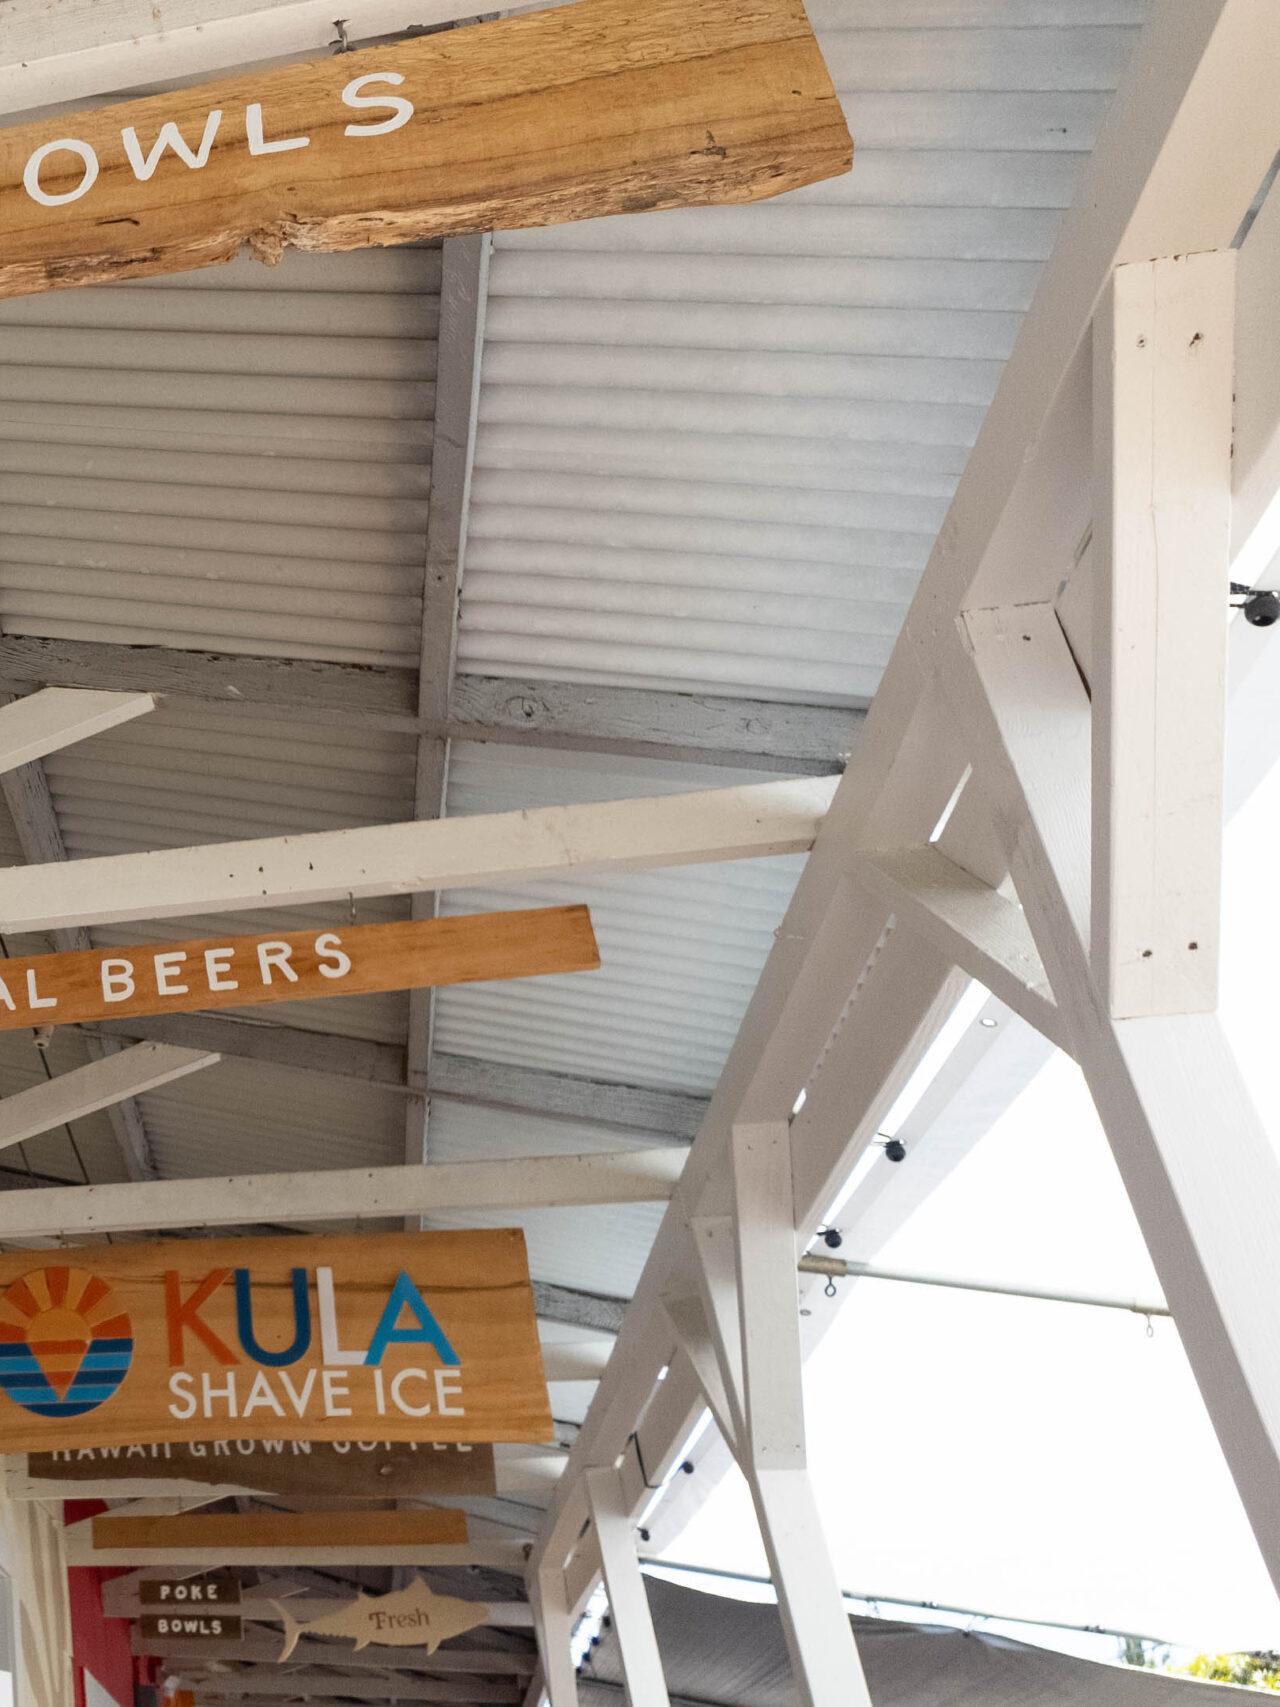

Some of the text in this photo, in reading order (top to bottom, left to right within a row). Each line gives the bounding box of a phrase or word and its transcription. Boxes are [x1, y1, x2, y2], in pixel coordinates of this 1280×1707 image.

[101, 933, 352, 1003] BEERS
[164, 1266, 462, 1368] KULA
[168, 1368, 465, 1419] SHAVE ICE
[188, 1439, 313, 1457] GROWN
[160, 1584, 218, 1600] POKE
[157, 1619, 223, 1635] BOWLS
[368, 1608, 431, 1632] Fresh
